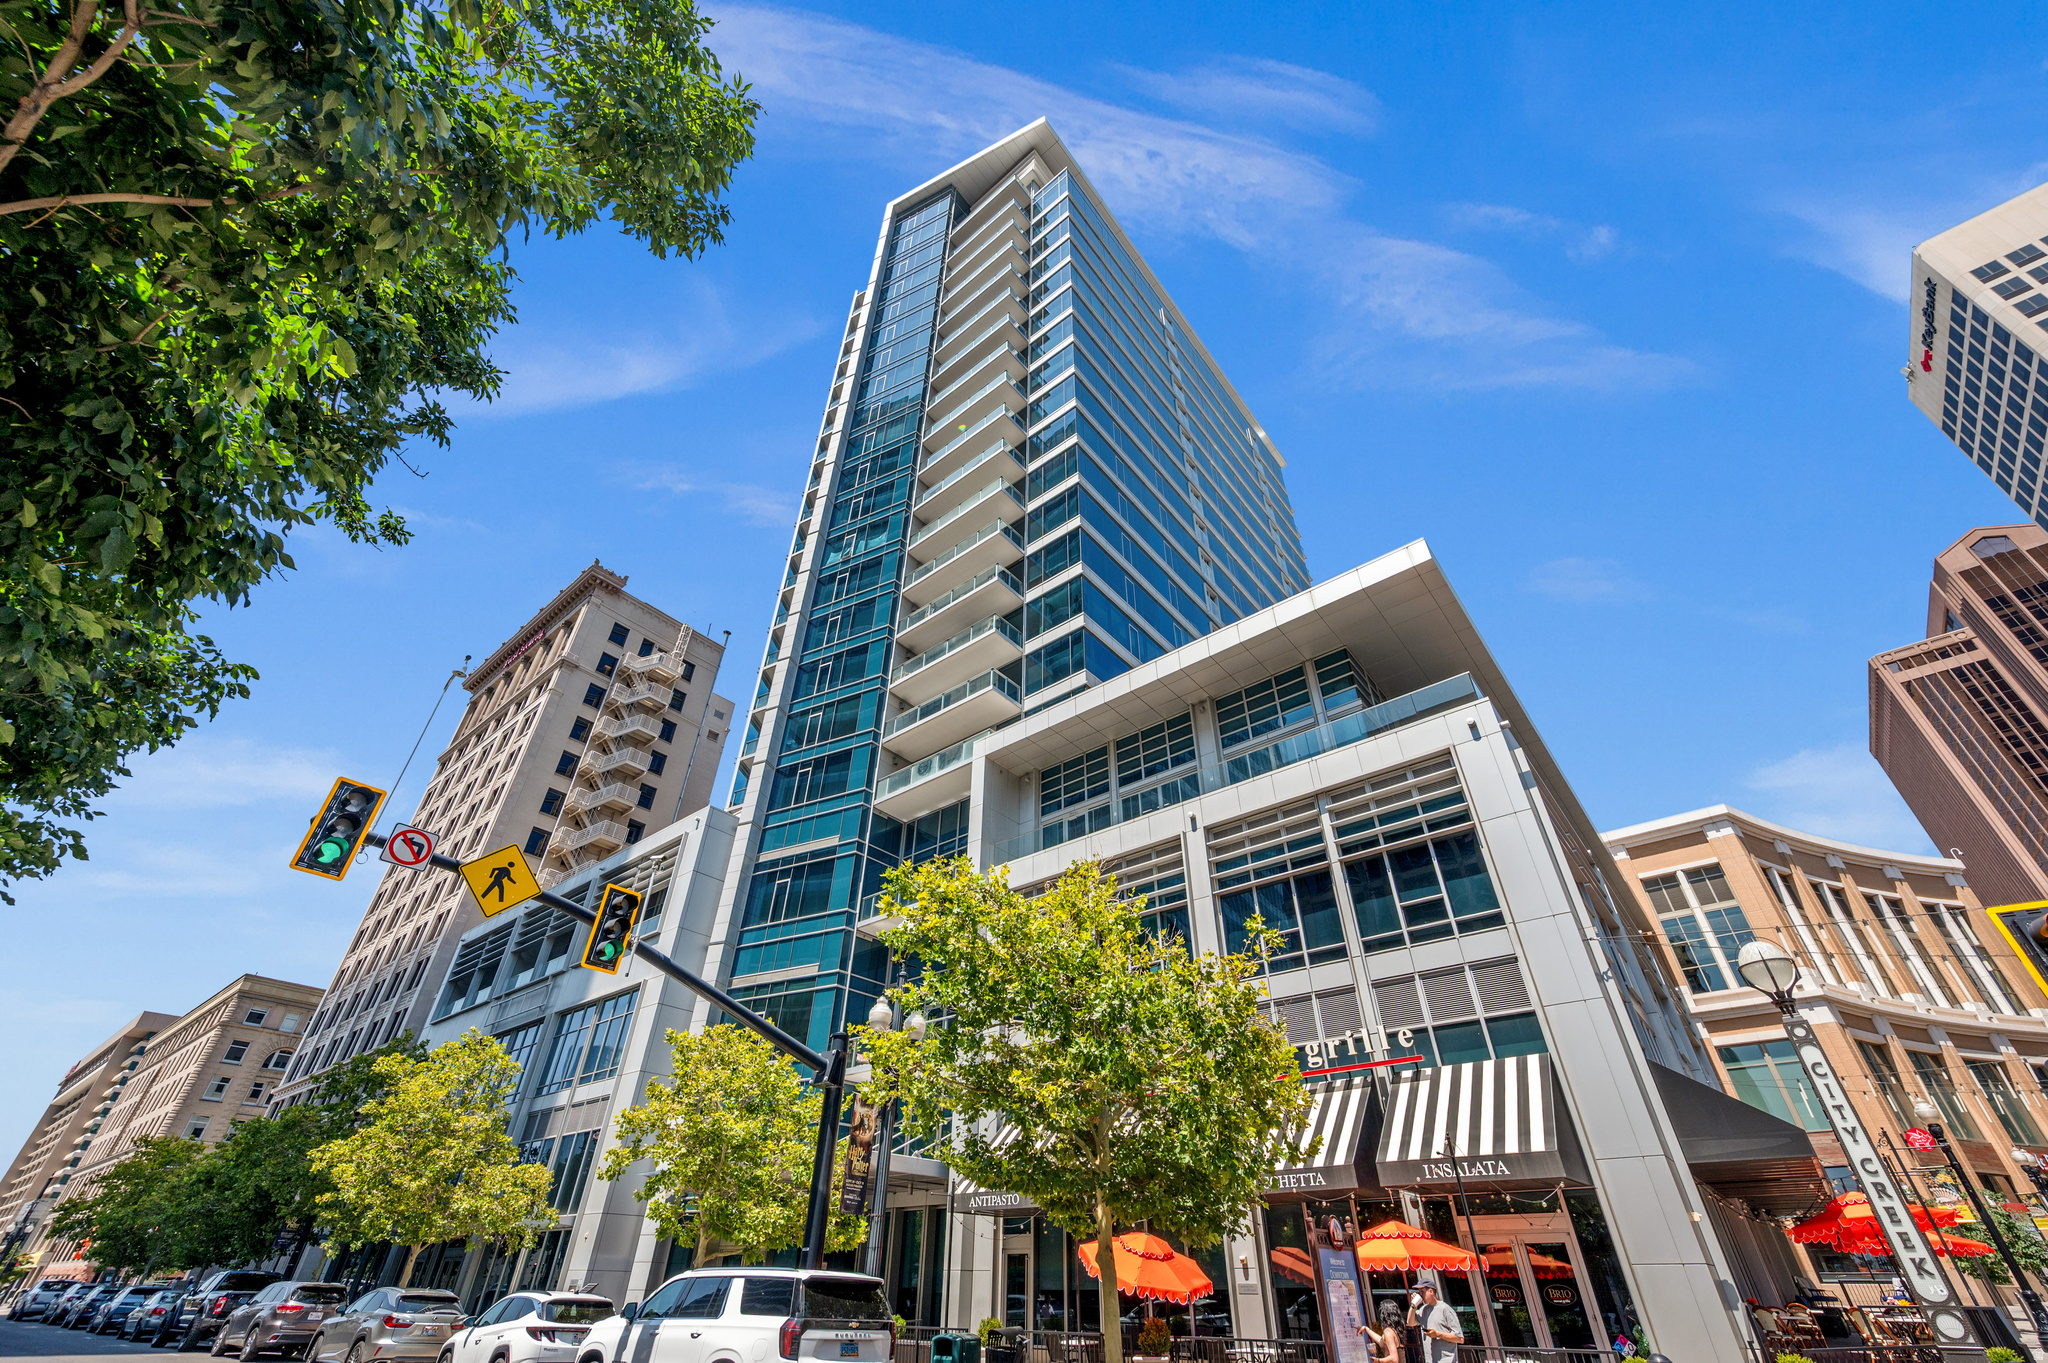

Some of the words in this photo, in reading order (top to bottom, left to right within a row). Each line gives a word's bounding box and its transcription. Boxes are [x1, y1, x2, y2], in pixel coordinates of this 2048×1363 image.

[1921, 277, 1937, 351] KeyBank
[1305, 1025, 1415, 1068] grille
[1422, 1160, 1511, 1179] INSALATA
[1811, 1061, 1859, 1143] CITY
[1860, 1157, 1935, 1278] CREEK
[968, 1194, 1020, 1207] ANTIPASTO
[1494, 1288, 1517, 1298] BRIO
[1548, 1288, 1572, 1299] BRIO
